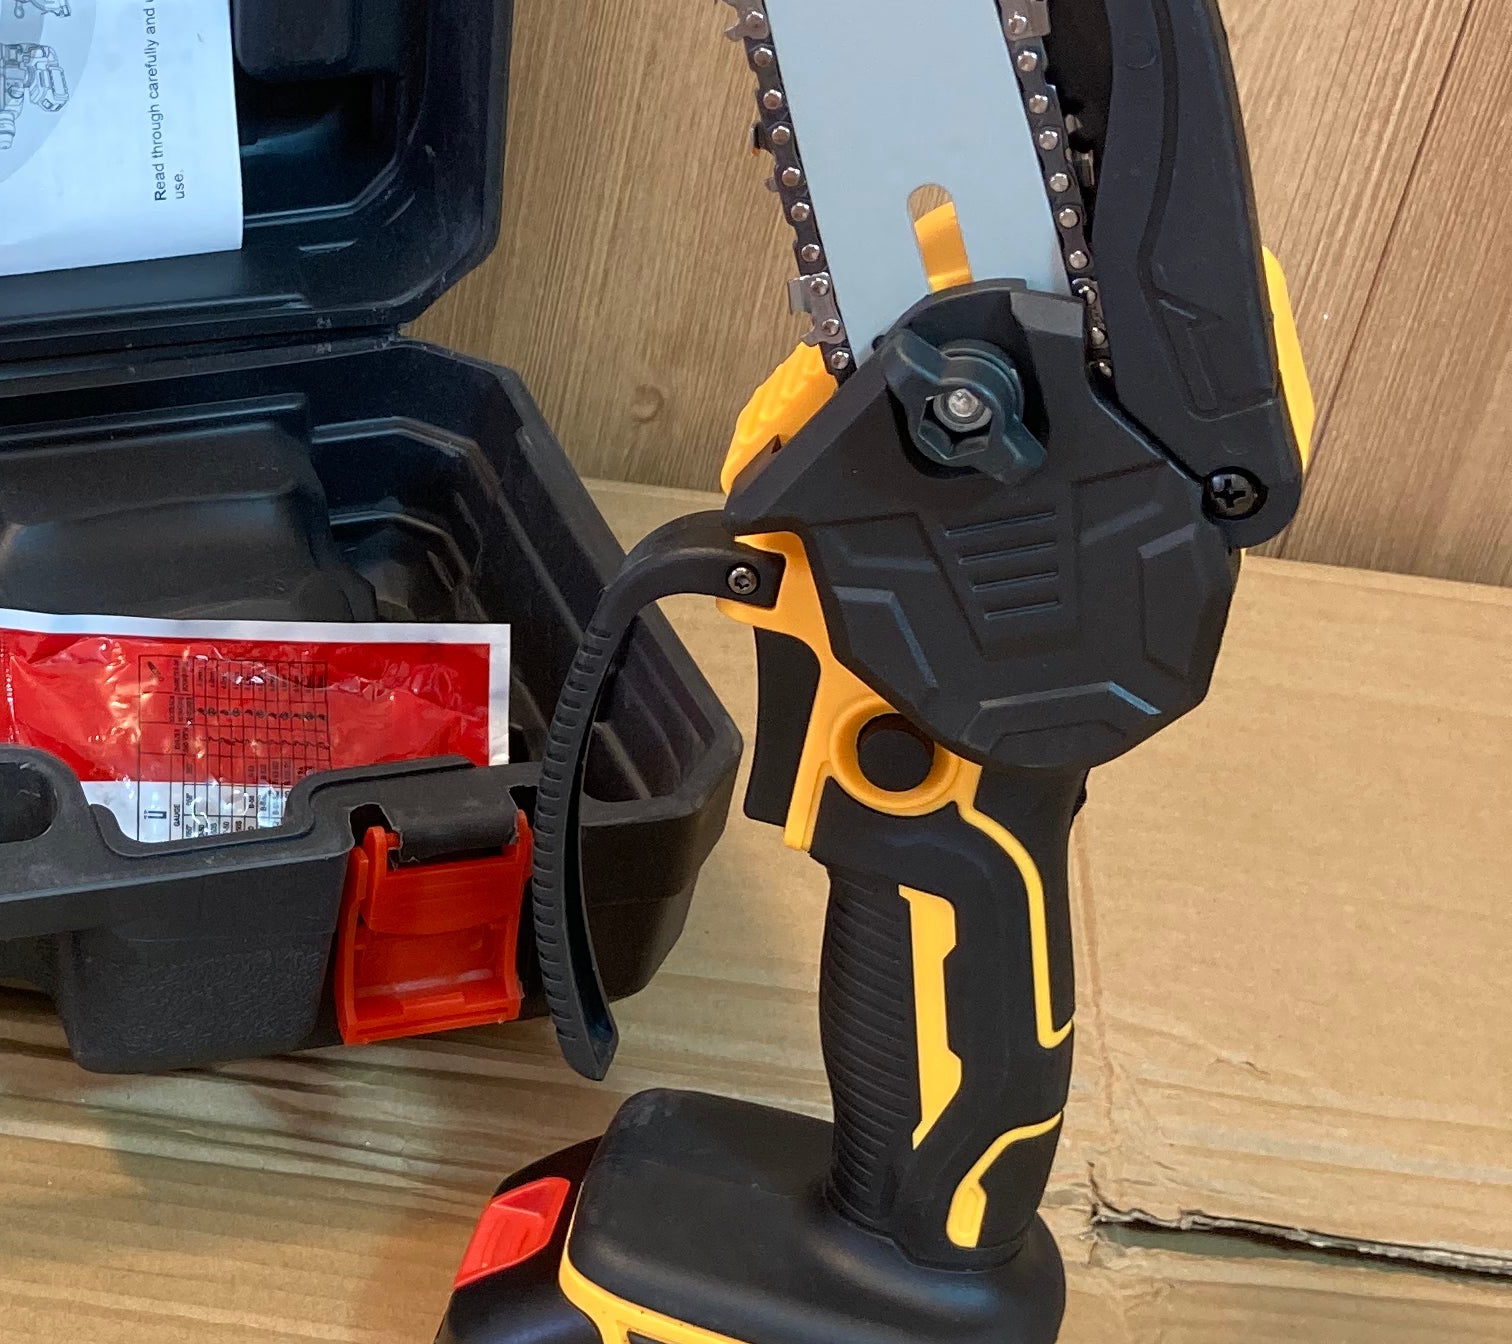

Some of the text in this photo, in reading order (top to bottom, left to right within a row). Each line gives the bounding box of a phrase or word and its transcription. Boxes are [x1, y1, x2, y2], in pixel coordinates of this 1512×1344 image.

[143, 6, 156, 35] and
[144, 38, 160, 100] carefully
[148, 103, 164, 160] through
[152, 163, 168, 202] Read
